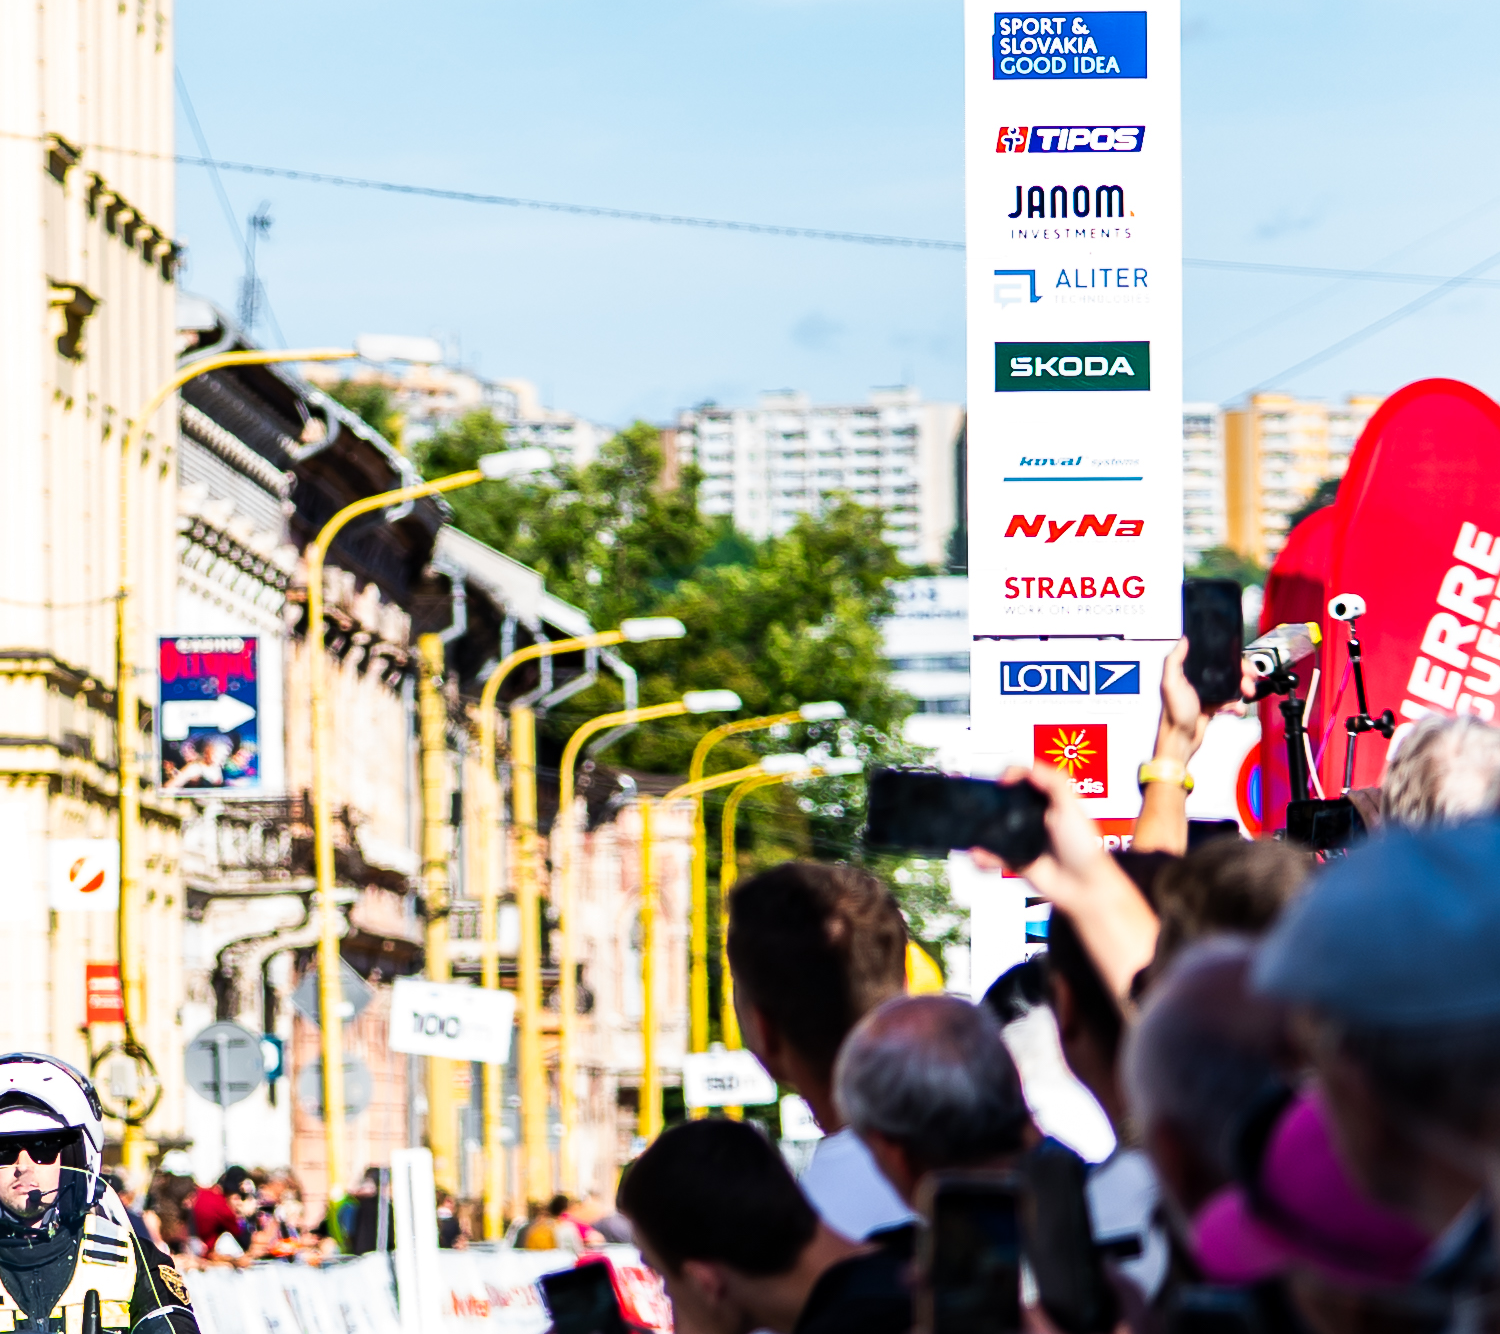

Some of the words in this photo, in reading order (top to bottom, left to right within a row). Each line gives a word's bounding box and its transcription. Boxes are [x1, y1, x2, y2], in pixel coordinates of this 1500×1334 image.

[999, 17, 1067, 36] SPORT
[1071, 17, 1090, 35] &
[1000, 36, 1098, 55] SLOVAKIA
[1000, 56, 1067, 75] GOOD
[1074, 56, 1121, 74] IDEA
[1036, 127, 1140, 151] TIPOS
[1011, 227, 1132, 240] INVESTMENTS
[1055, 267, 1148, 289] ALITER
[1004, 575, 1146, 600] STRABAG
[1003, 664, 1088, 692] LOTN
